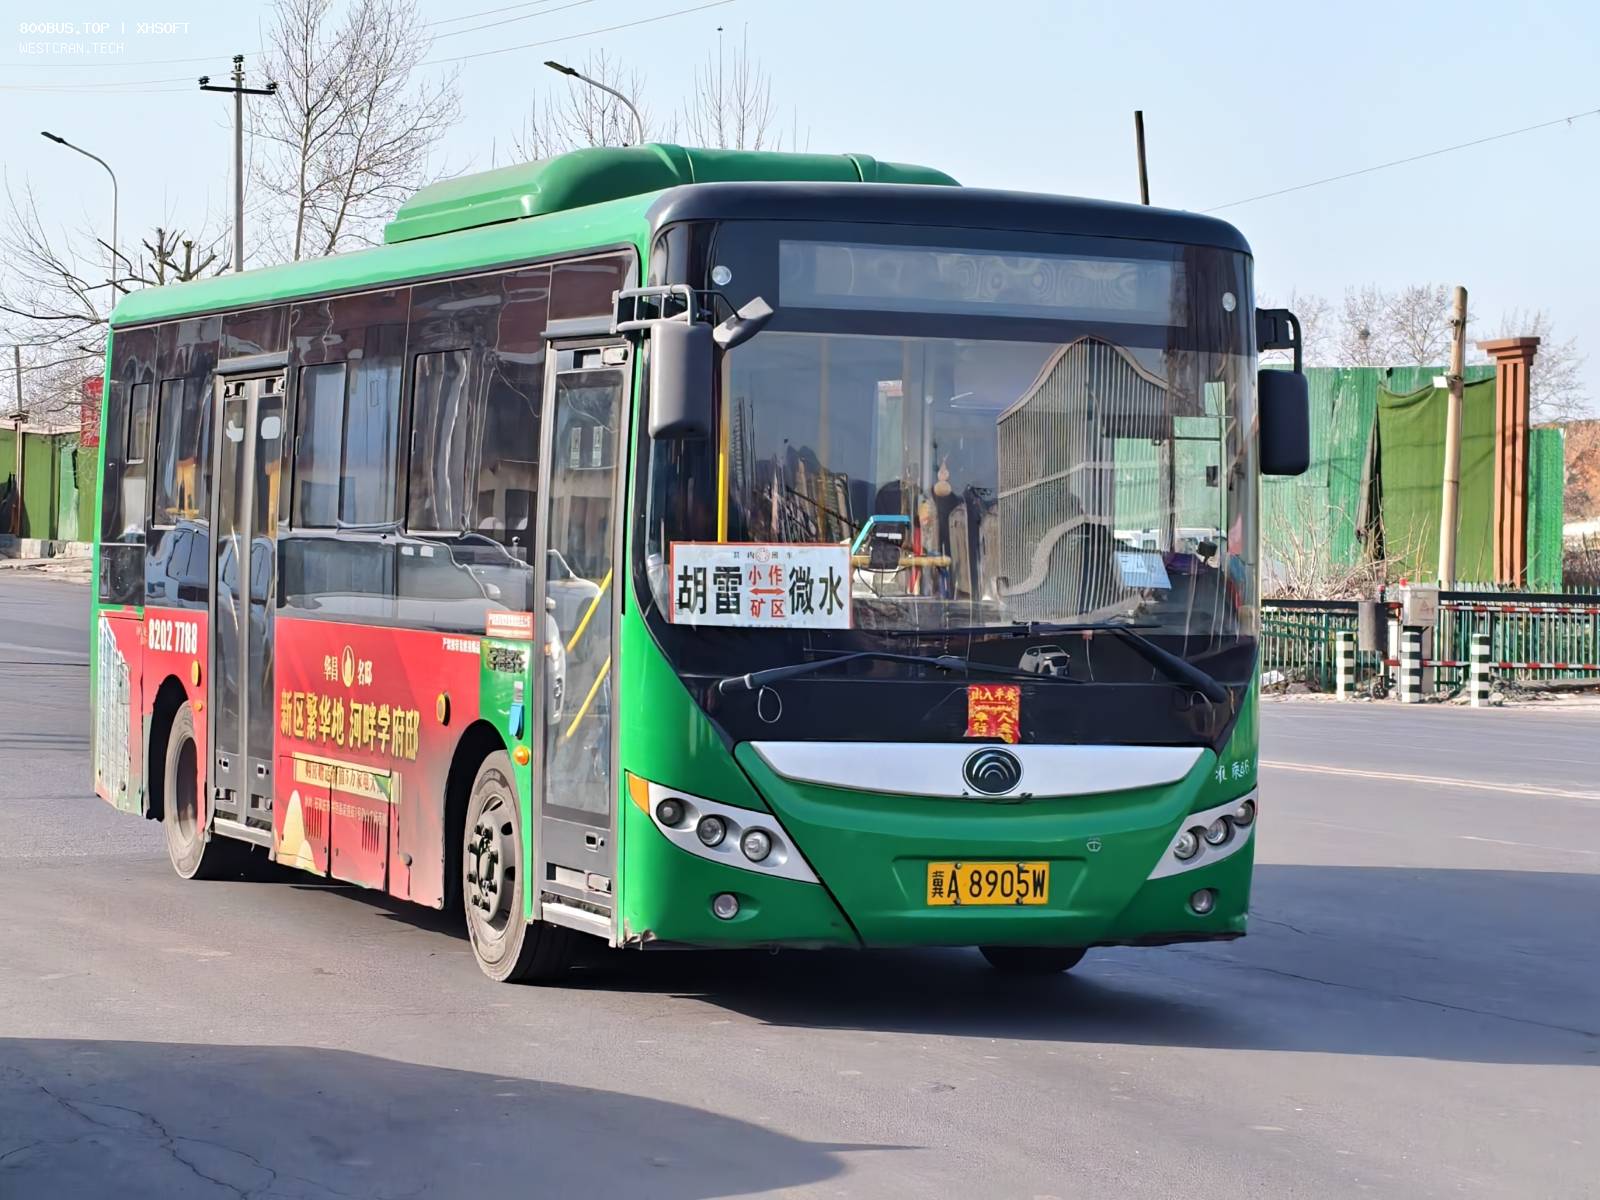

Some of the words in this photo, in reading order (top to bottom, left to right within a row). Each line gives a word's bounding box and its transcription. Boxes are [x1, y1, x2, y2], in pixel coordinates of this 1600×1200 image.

[677, 565, 743, 615] 胡雷
[748, 564, 784, 586] 小作
[789, 565, 844, 615] 微水
[750, 599, 785, 618] 矿区
[148, 618, 173, 651] 8202
[174, 621, 198, 654] 7788
[280, 687, 345, 746] 新区繁华地
[349, 697, 420, 761] 河畔学府邸
